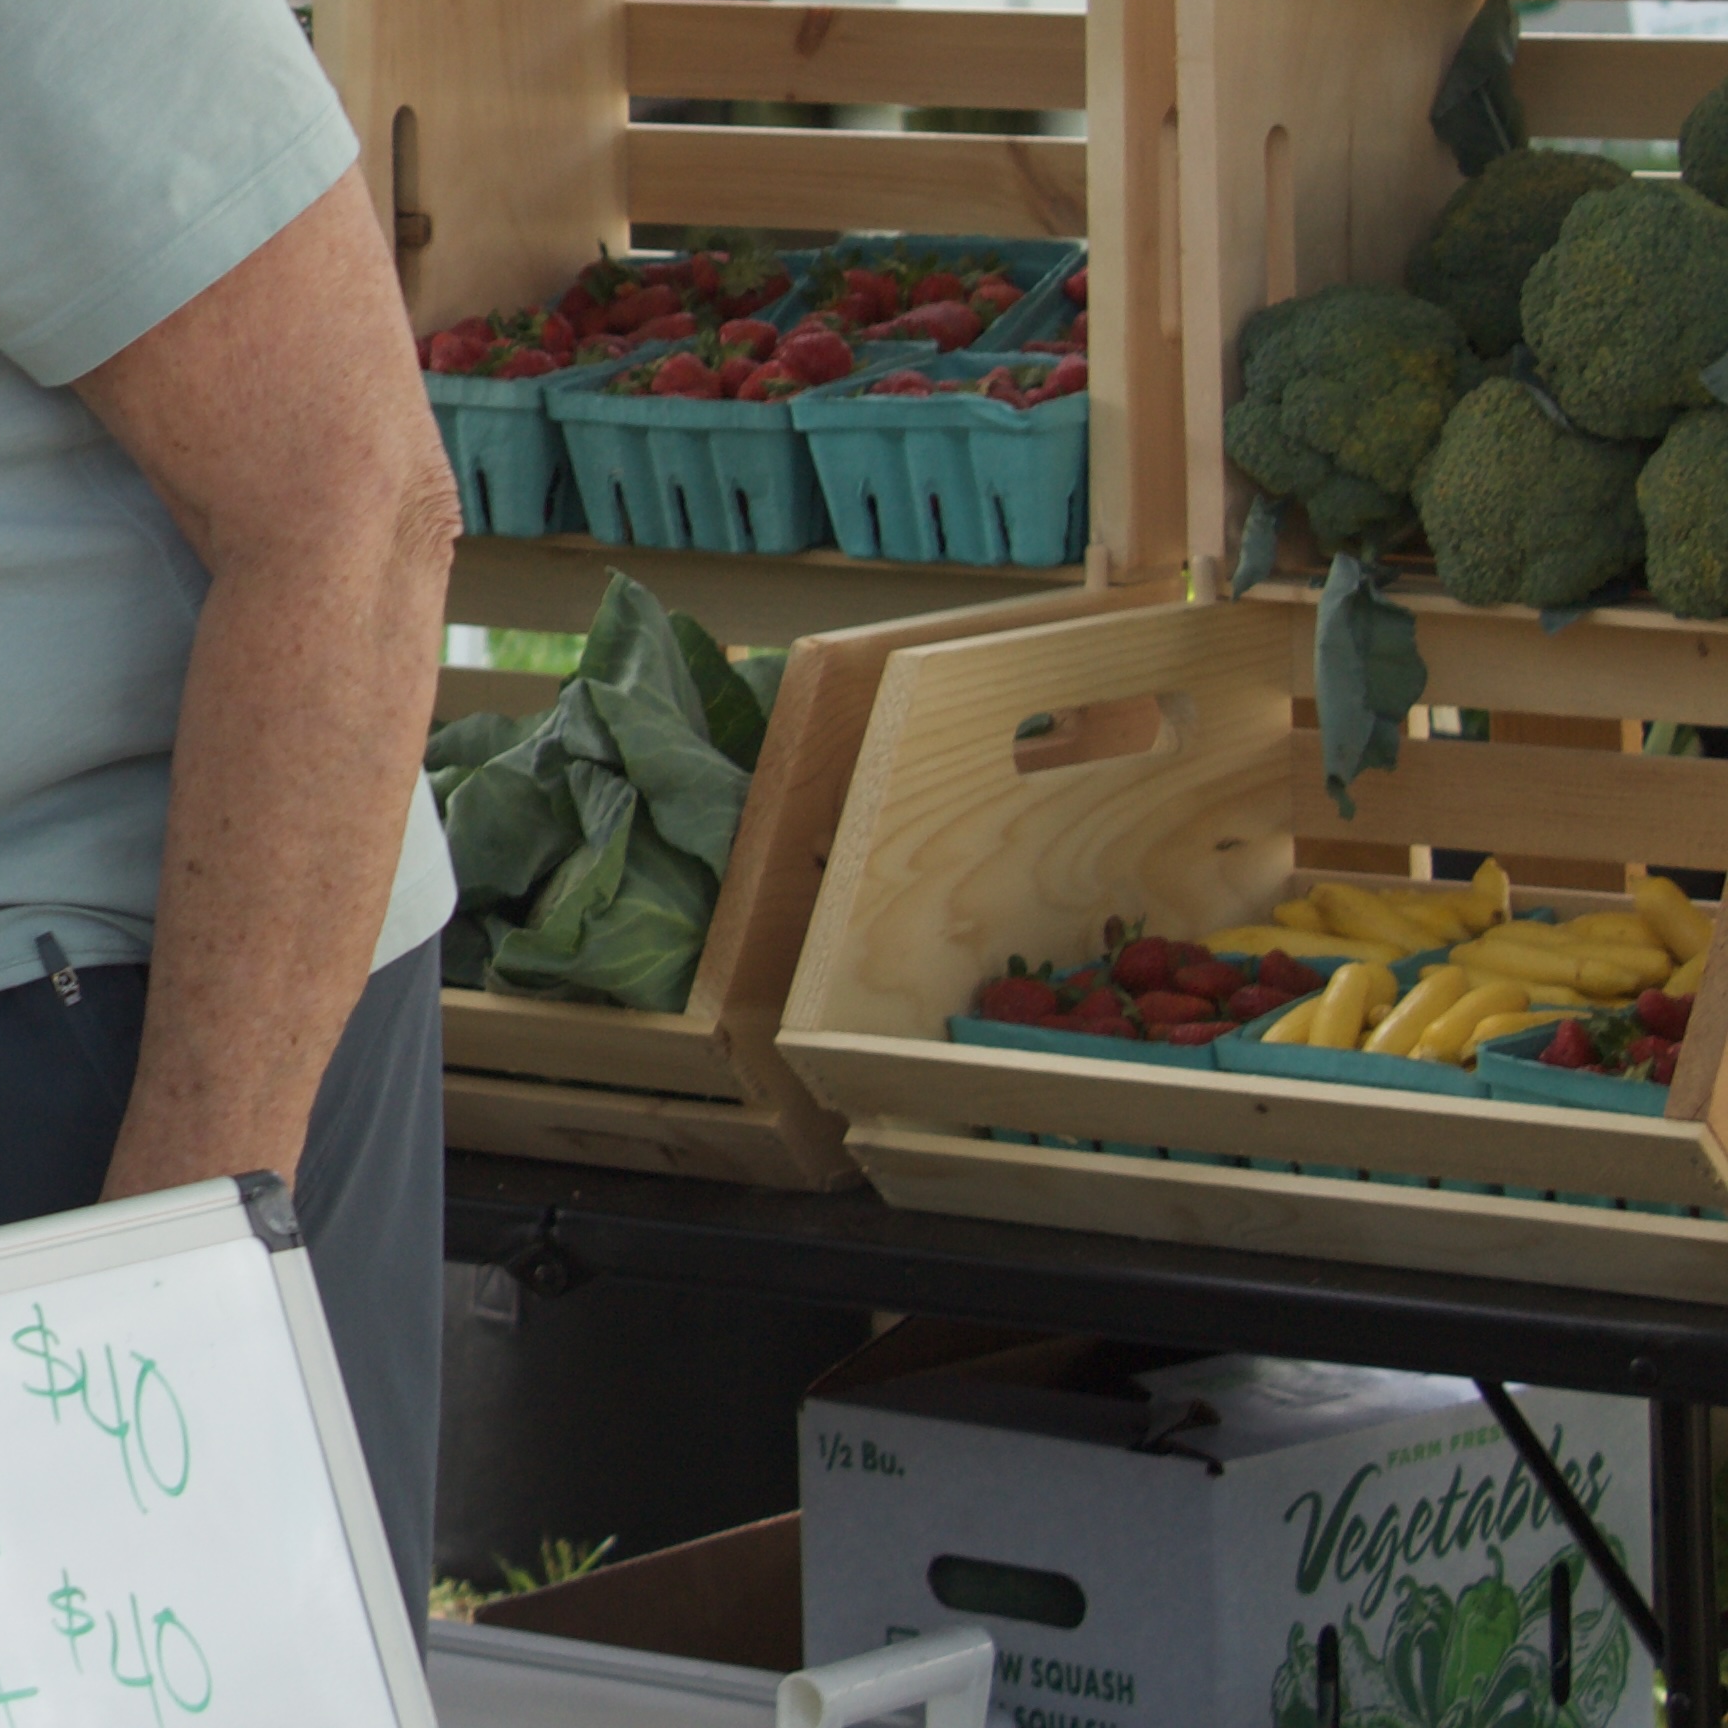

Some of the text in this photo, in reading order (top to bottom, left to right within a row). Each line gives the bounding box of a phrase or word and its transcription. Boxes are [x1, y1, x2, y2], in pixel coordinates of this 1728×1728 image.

[12, 1302, 191, 1517] $40
[860, 1440, 907, 1478] Bu.
[1387, 1422, 1506, 1469] FARM FRES
[47, 1568, 214, 1728] $40
[1030, 1656, 1135, 1706] SQUASH
